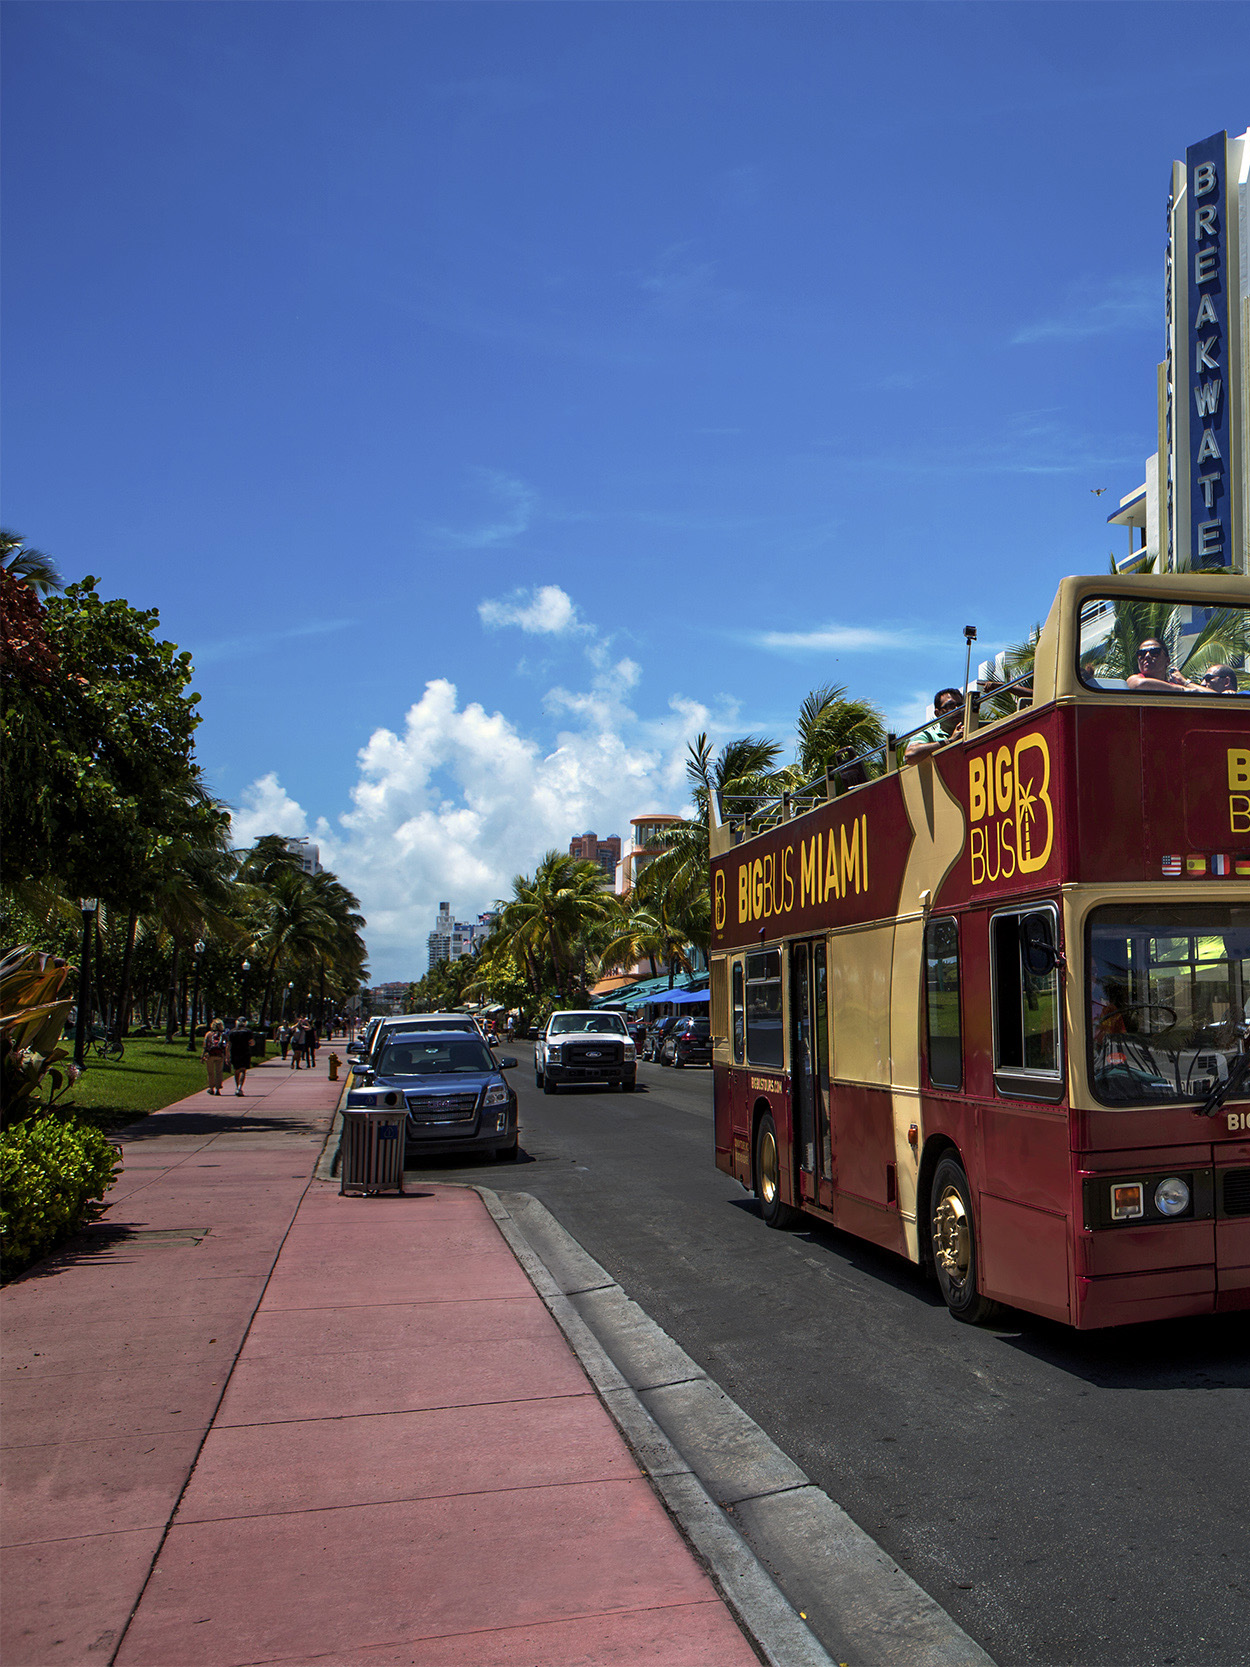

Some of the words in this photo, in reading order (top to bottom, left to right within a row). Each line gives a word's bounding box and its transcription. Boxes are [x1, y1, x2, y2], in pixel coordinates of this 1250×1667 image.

[969, 745, 1013, 822] BIG
[800, 813, 868, 908] MIAMI
[970, 818, 1016, 885] BUS
